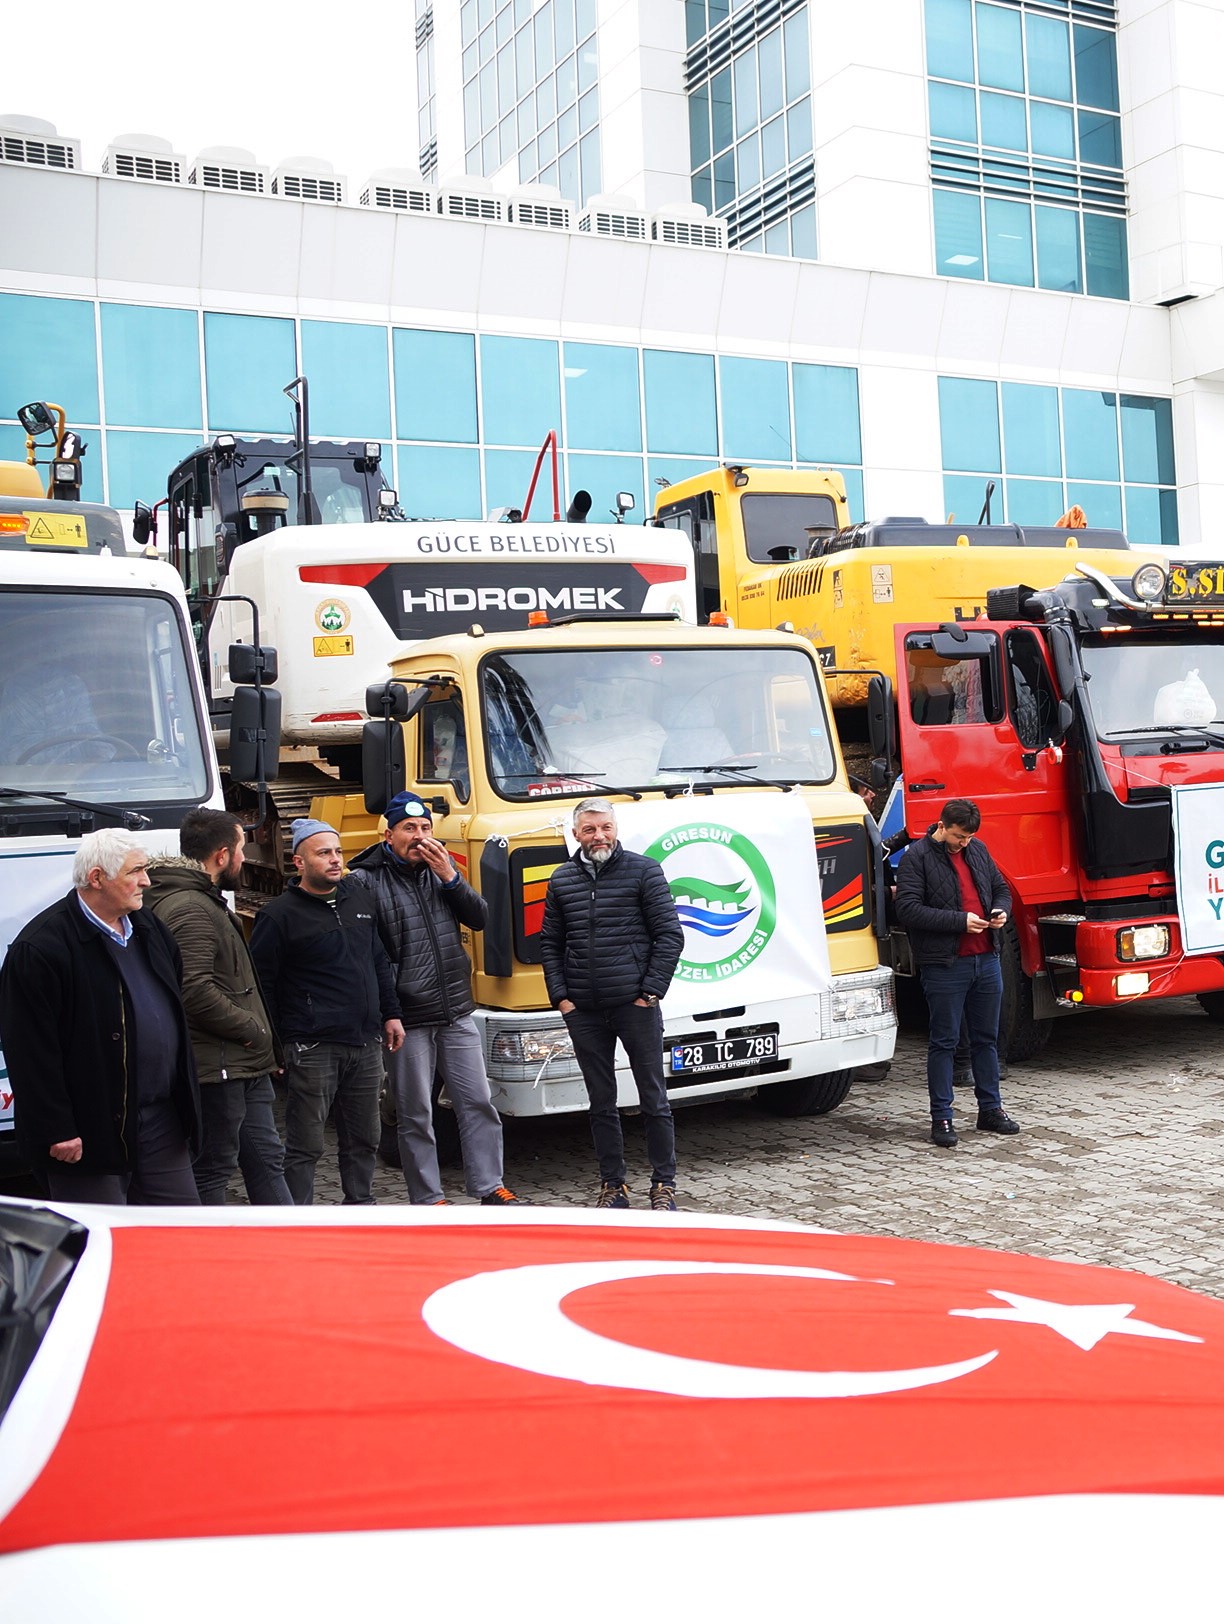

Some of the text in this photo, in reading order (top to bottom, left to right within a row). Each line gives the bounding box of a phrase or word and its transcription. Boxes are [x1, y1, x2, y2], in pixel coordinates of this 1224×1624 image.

[416, 532, 615, 554] GÜCE BELEDİYESİ
[661, 827, 734, 852] GİRESUN
[1207, 873, 1224, 894] İL
[714, 928, 769, 978] İDARESİ
[683, 1036, 774, 1066] 28 TC 789
